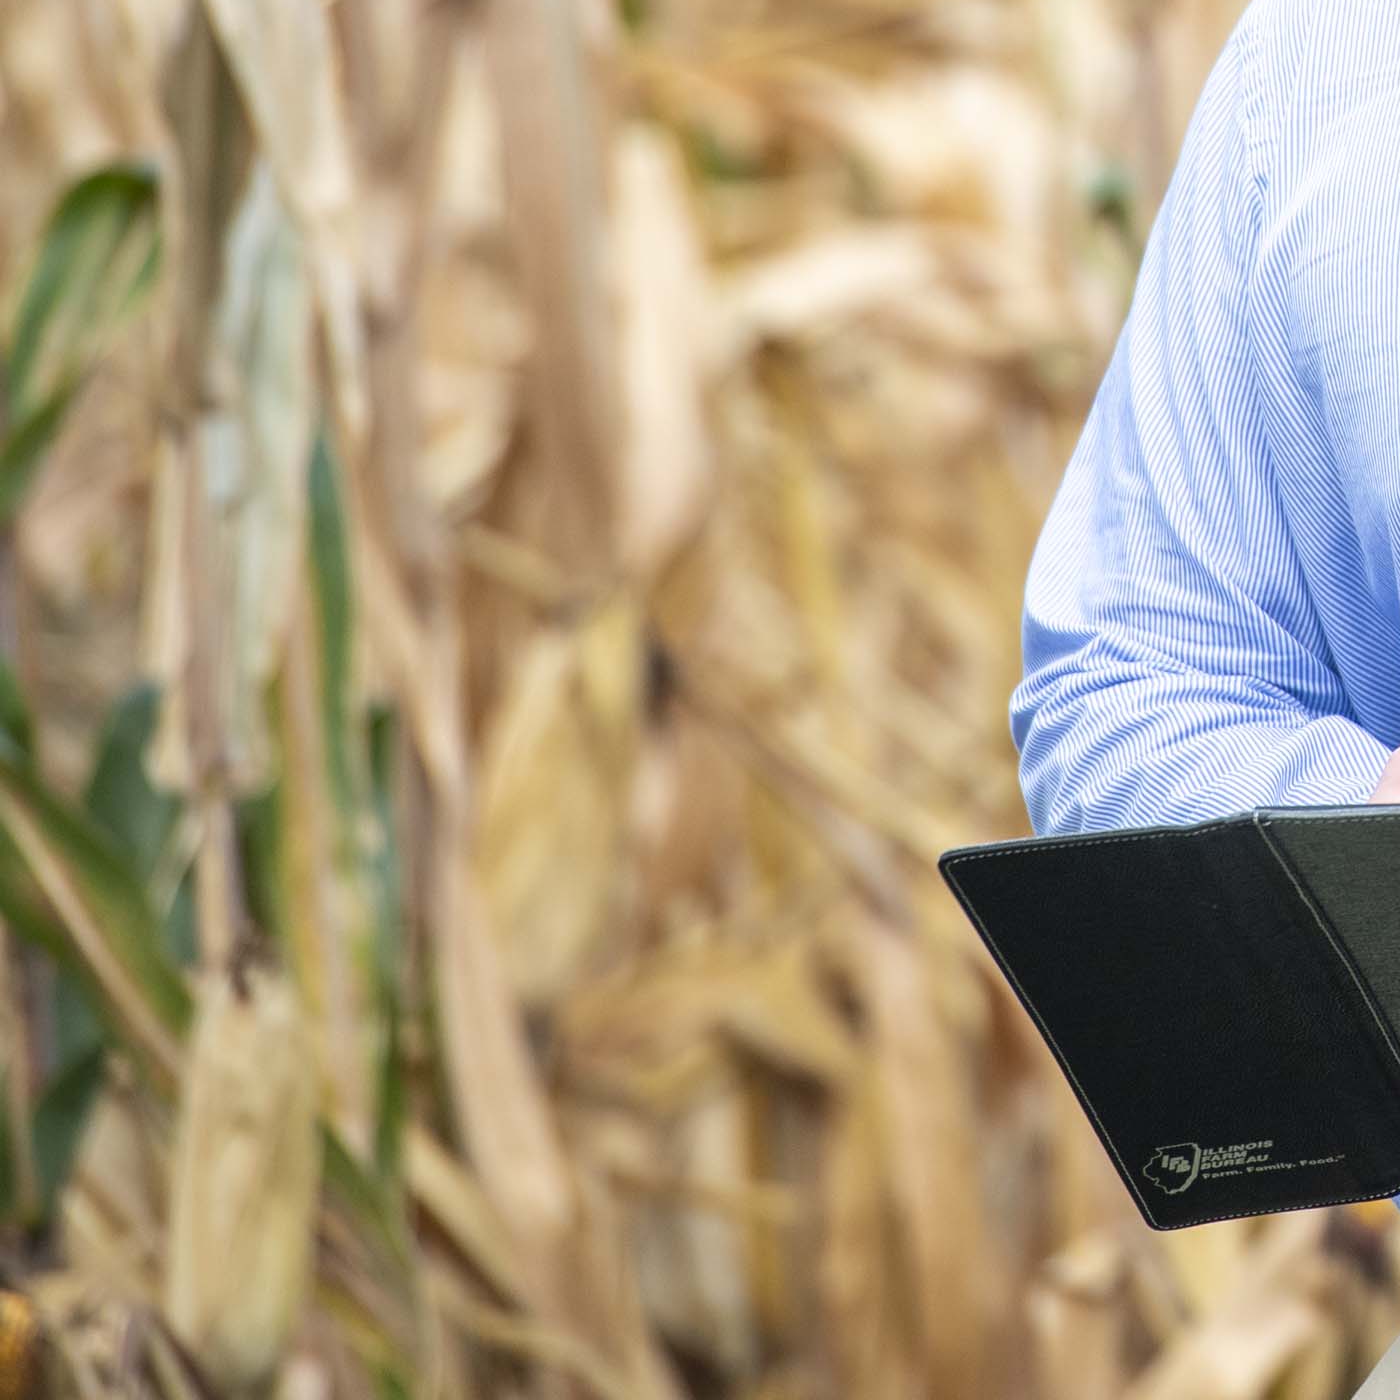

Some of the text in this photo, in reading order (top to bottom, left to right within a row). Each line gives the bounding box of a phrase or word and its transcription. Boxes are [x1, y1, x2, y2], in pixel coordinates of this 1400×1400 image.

[1202, 1140, 1273, 1156] ILLINOIS
[1200, 1154, 1269, 1169] BUREAU
[1201, 1150, 1248, 1163] FARM
